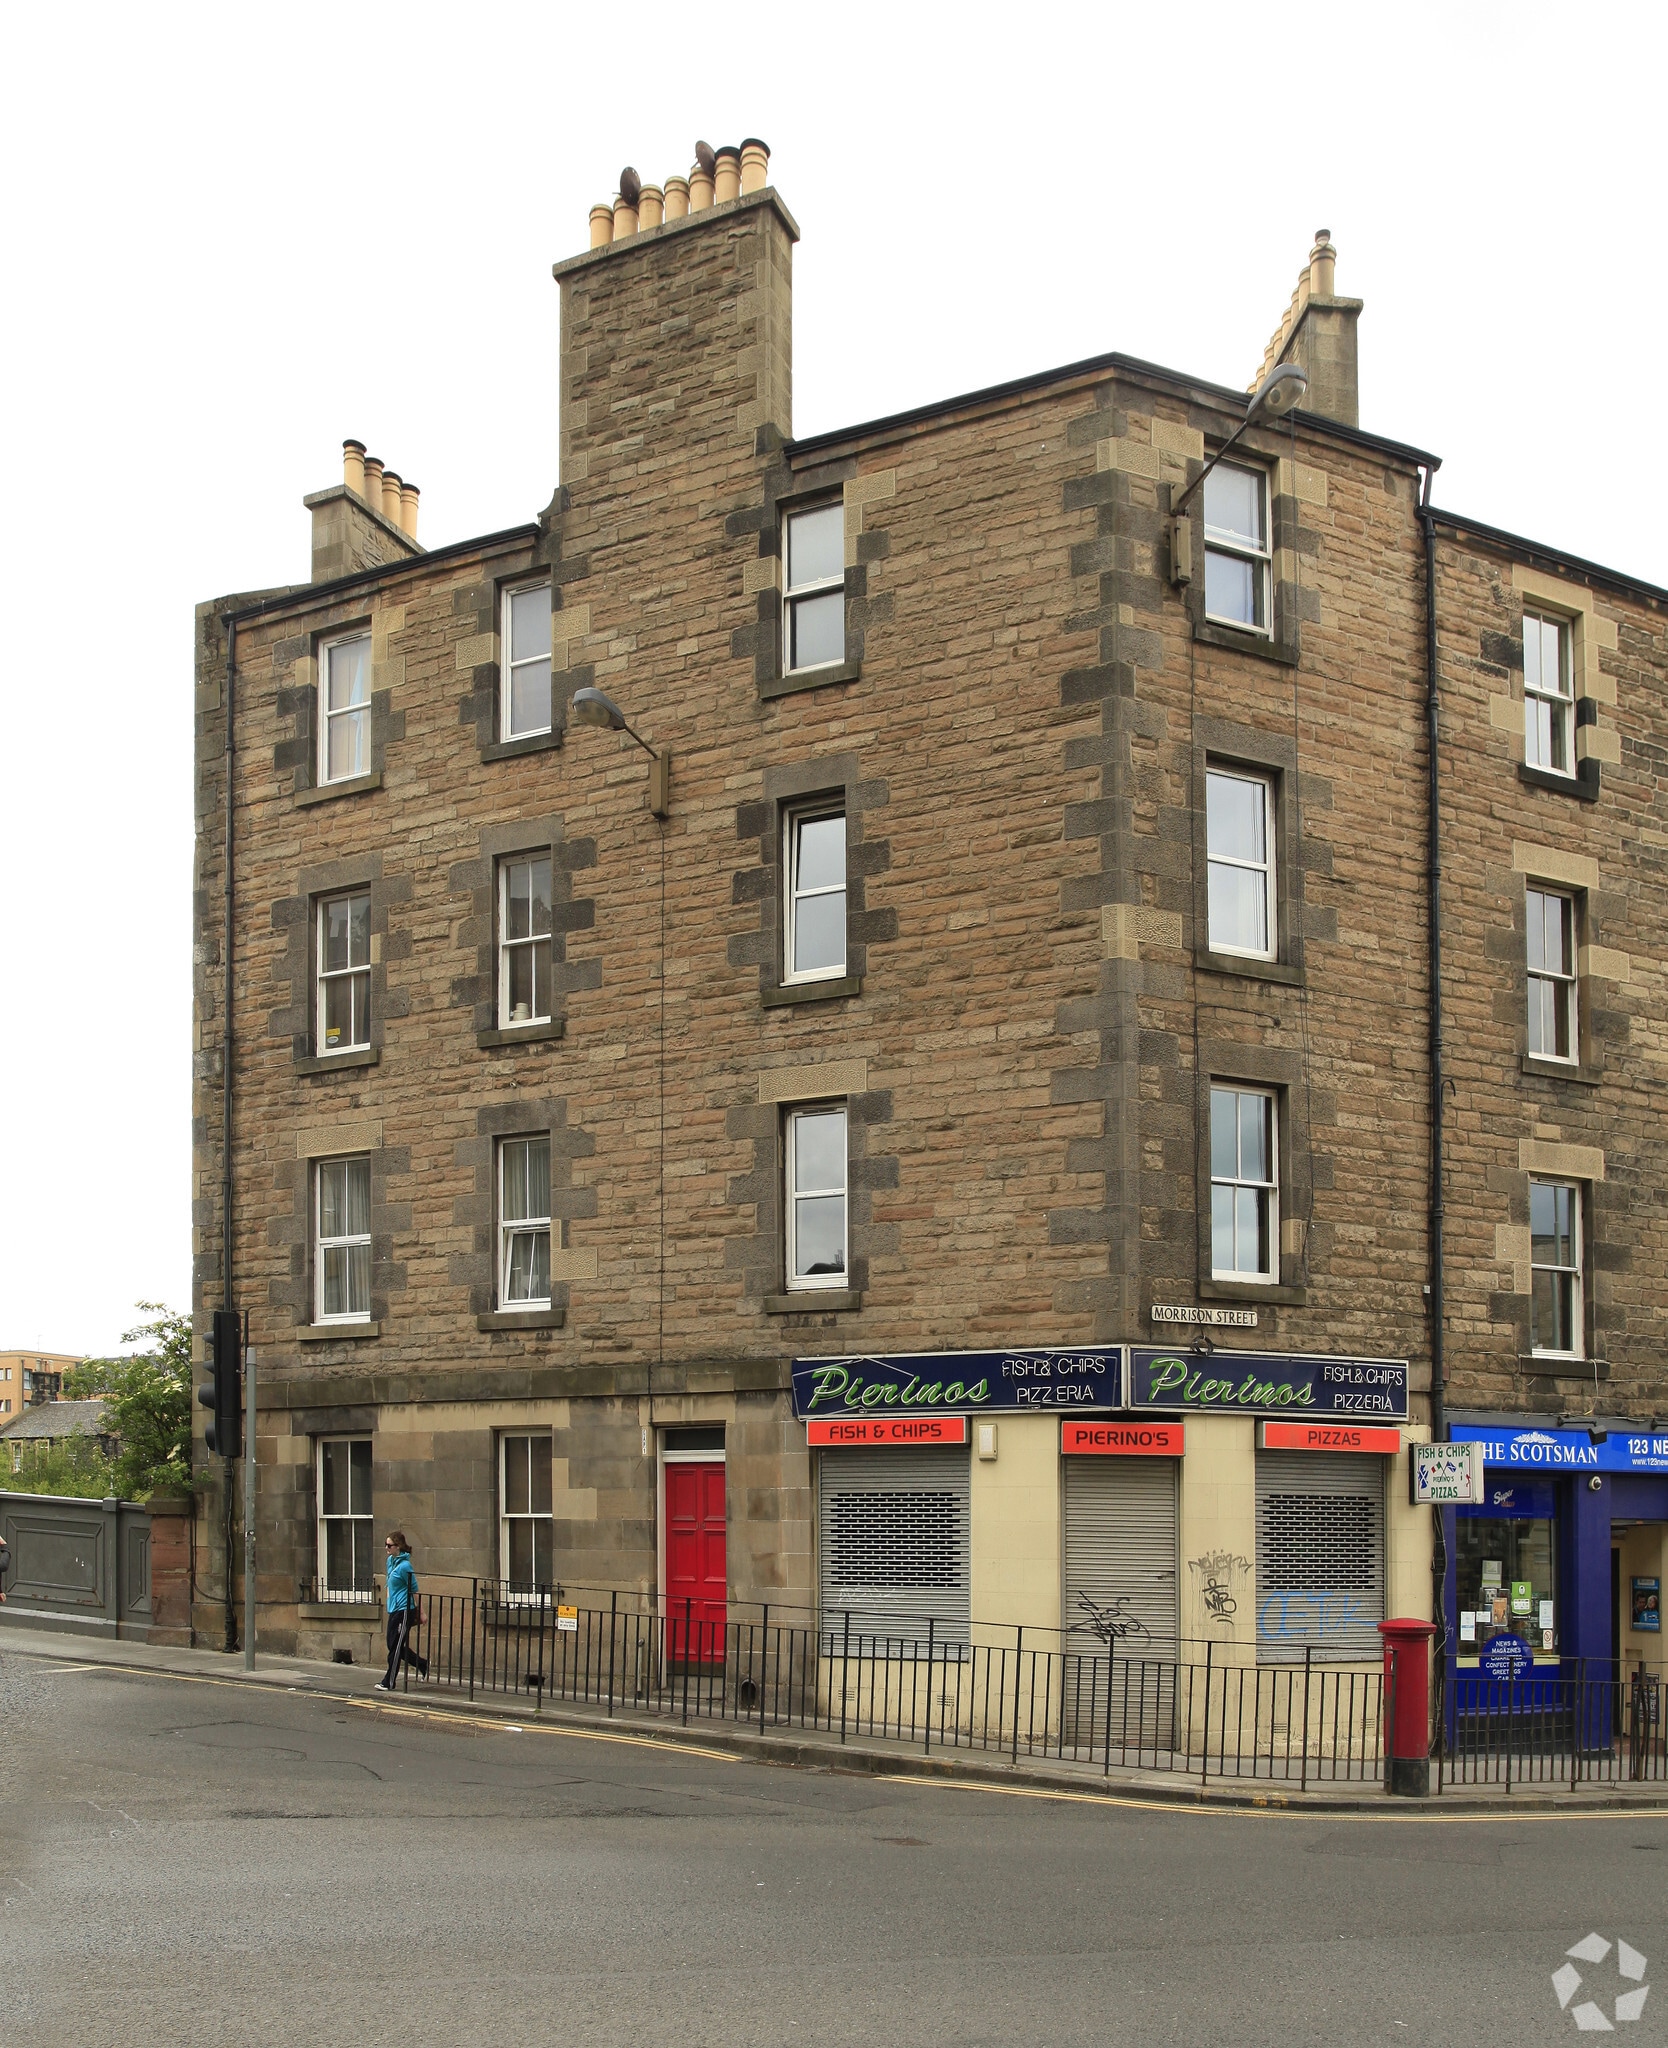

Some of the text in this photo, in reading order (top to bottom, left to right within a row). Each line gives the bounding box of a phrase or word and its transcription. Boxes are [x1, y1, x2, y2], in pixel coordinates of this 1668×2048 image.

[1154, 1307, 1255, 1325] MORRISON STREET
[1057, 1357, 1106, 1374] CHIPS
[1148, 1356, 1317, 1406] Pierinos
[1366, 1368, 1403, 1386] CHIPS
[806, 1364, 992, 1409] Pierinos
[1334, 1393, 1394, 1412] PIZZERIA
[829, 1423, 943, 1440] FISH & CHIPS
[1075, 1430, 1169, 1446] PIERINO'S
[1308, 1430, 1361, 1446] PIZZAS
[1417, 1445, 1471, 1459] FISH & CHIPS
[1482, 1442, 1598, 1464] HE SCOTSMAN
[1627, 1438, 1649, 1455] 123
[1430, 1486, 1459, 1499] PIZZAS
[1493, 1489, 1514, 1505] Super
